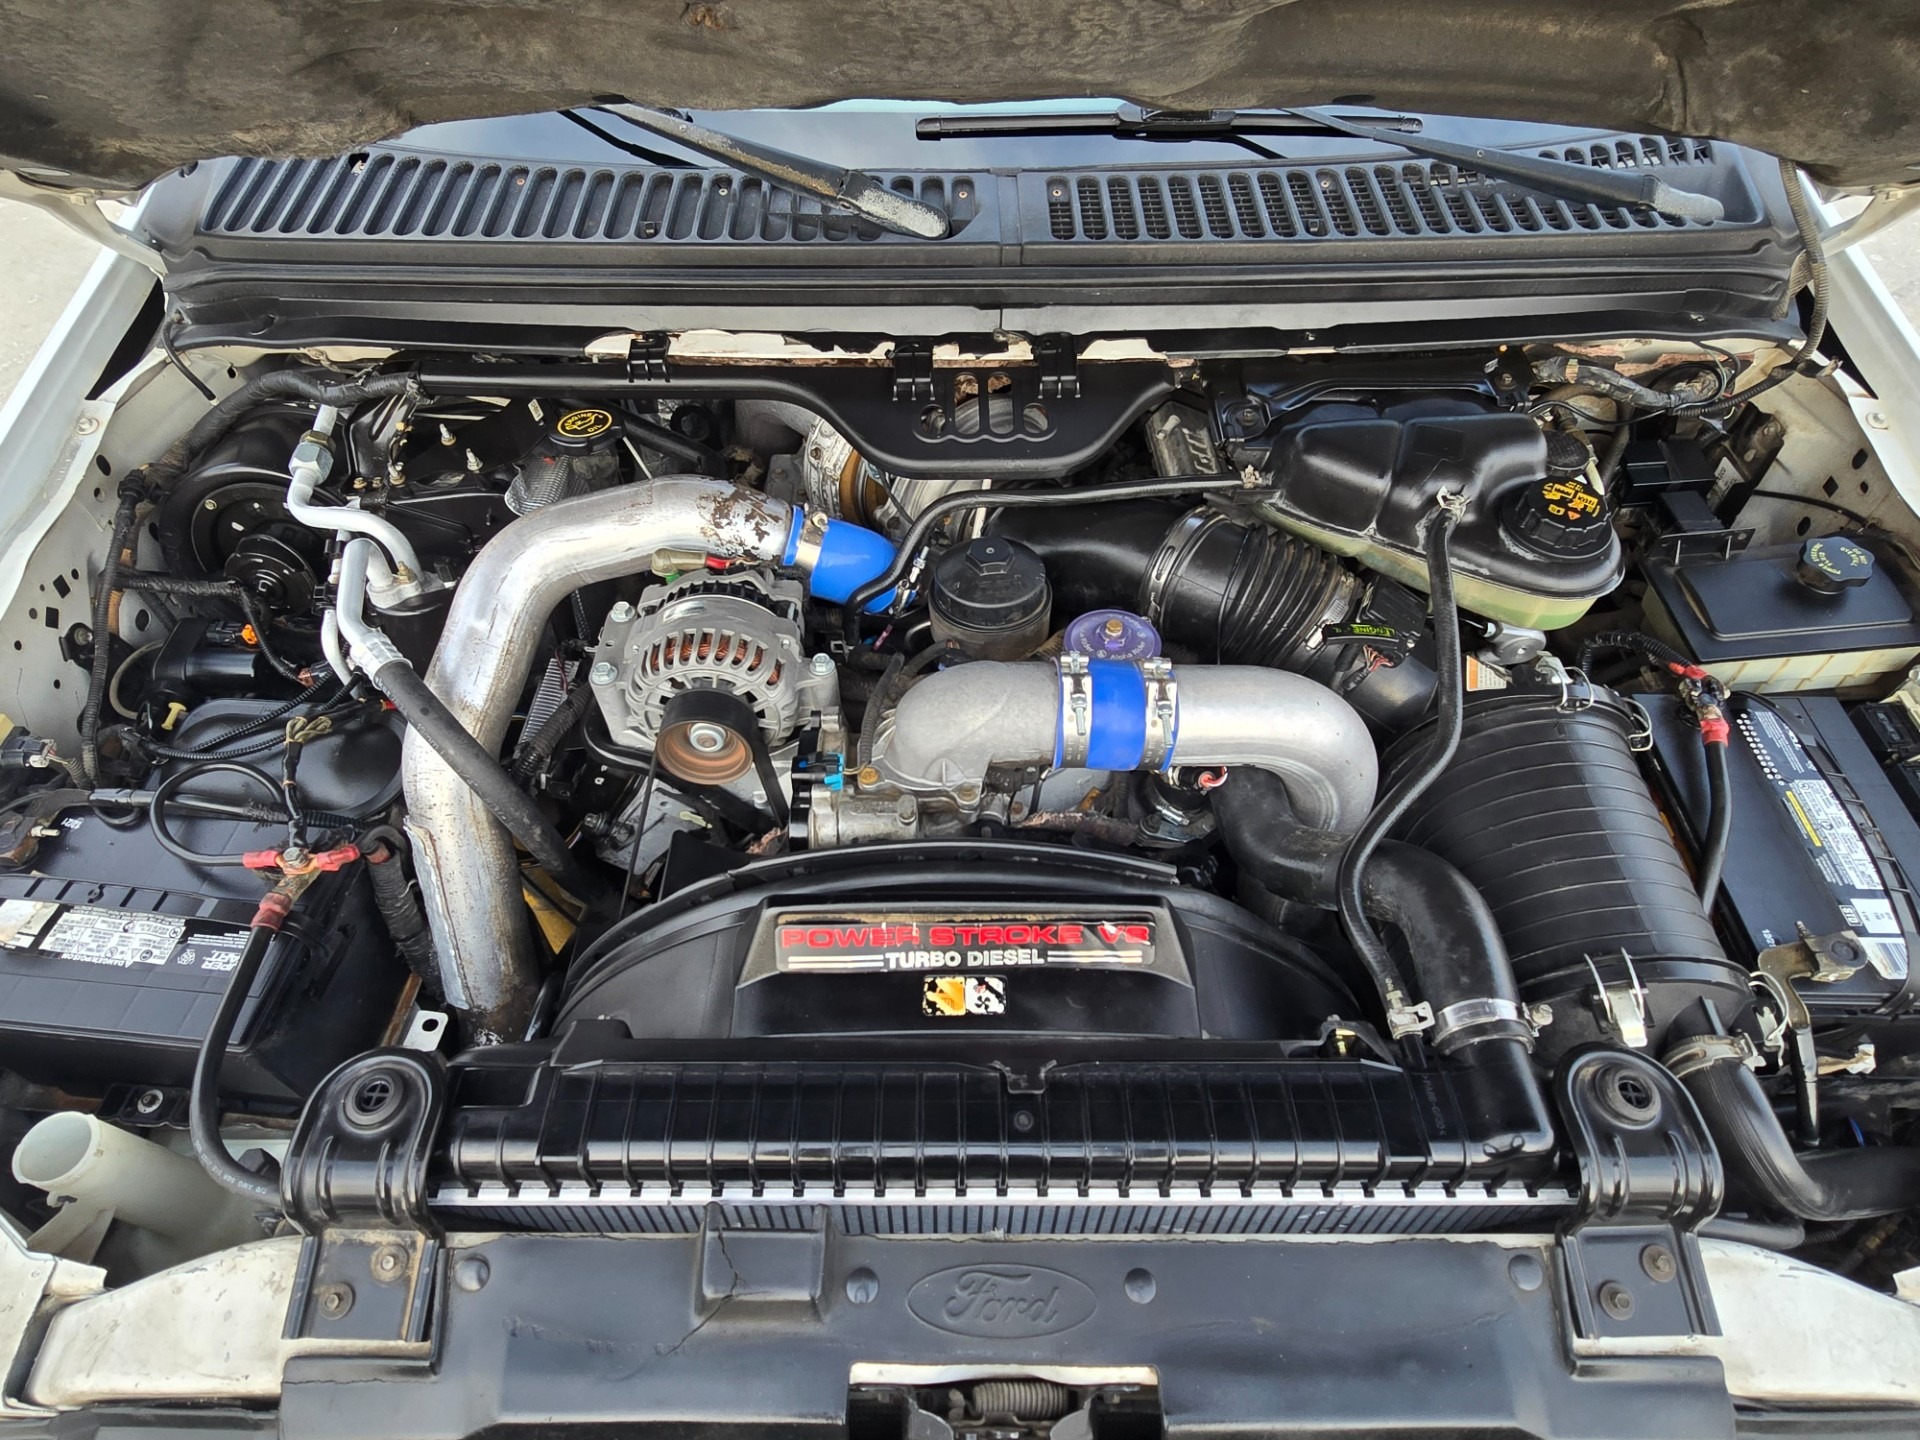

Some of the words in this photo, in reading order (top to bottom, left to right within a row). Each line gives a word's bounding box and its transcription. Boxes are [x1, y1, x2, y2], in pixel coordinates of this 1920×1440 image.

[565, 412, 594, 430] ENGINE
[1110, 653, 1133, 661] Alpha
[1131, 641, 1146, 656] Rider
[781, 926, 920, 948] POWER
[929, 925, 1083, 947] STROKE
[1097, 924, 1150, 944] V8
[884, 951, 961, 969] TURBO
[967, 949, 1045, 967] DIESEL
[944, 1270, 1060, 1323] Ford
